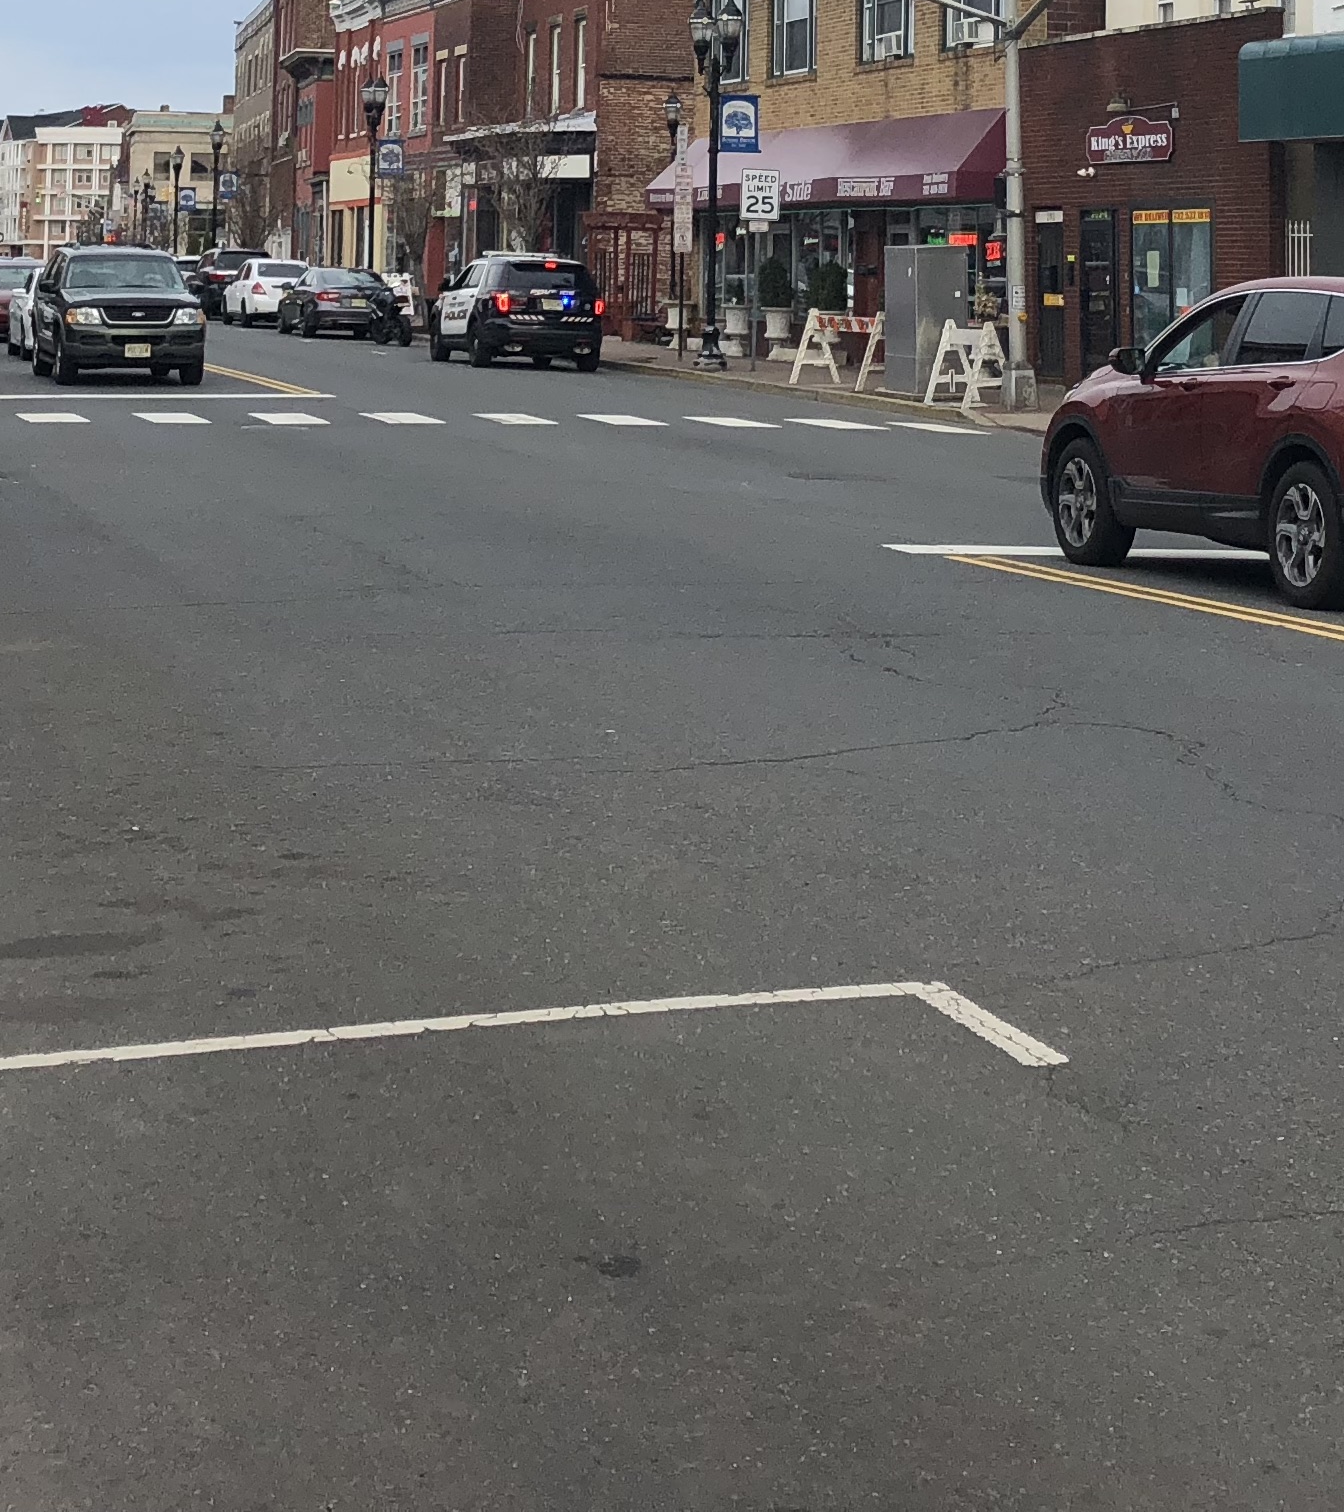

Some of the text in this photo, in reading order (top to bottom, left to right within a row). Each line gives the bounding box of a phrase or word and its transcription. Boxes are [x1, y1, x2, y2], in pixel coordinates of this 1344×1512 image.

[1090, 133, 1167, 151] King's Express
[744, 174, 777, 184] SPEED
[747, 185, 773, 193] LIMIT
[784, 181, 812, 202] Side
[745, 195, 775, 214] 25
